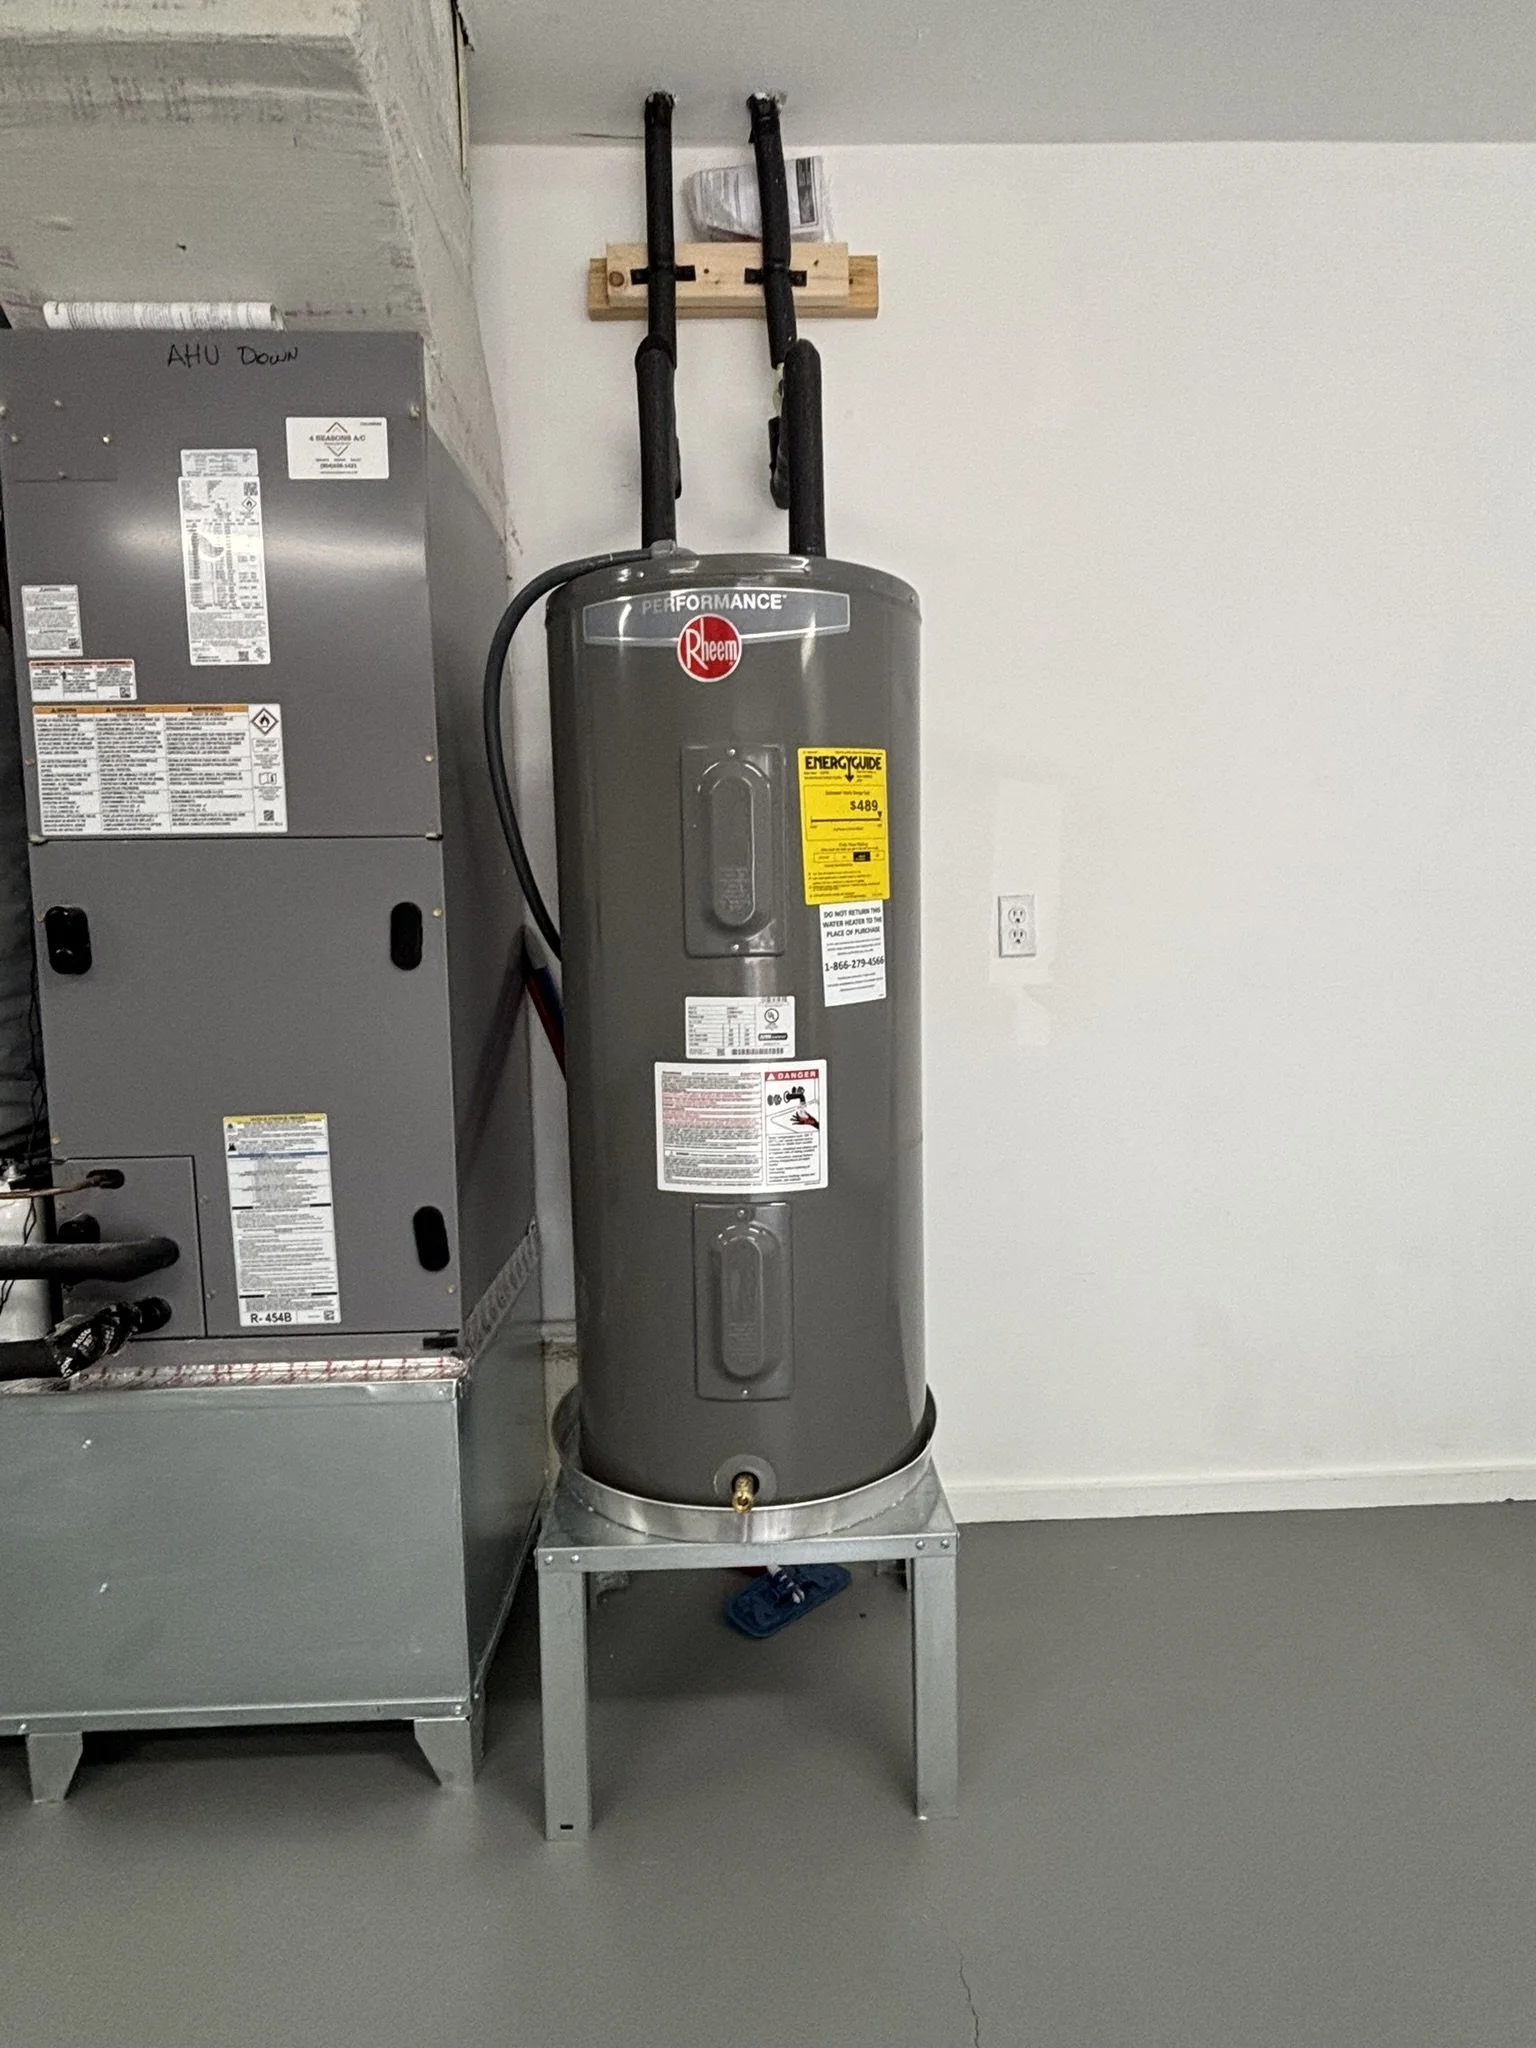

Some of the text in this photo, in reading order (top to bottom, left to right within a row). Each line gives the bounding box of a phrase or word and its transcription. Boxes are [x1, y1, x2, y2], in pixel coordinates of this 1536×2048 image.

[168, 343, 219, 368] AHU
[685, 618, 737, 671] Rheem
[849, 800, 879, 812] $489
[849, 908, 870, 916] RETURN
[822, 920, 843, 928] WATER
[845, 918, 865, 926] HEATER
[855, 926, 880, 935] PURCHASE
[825, 956, 884, 972] 1-866-279-4566
[777, 1070, 816, 1080] DANGER
